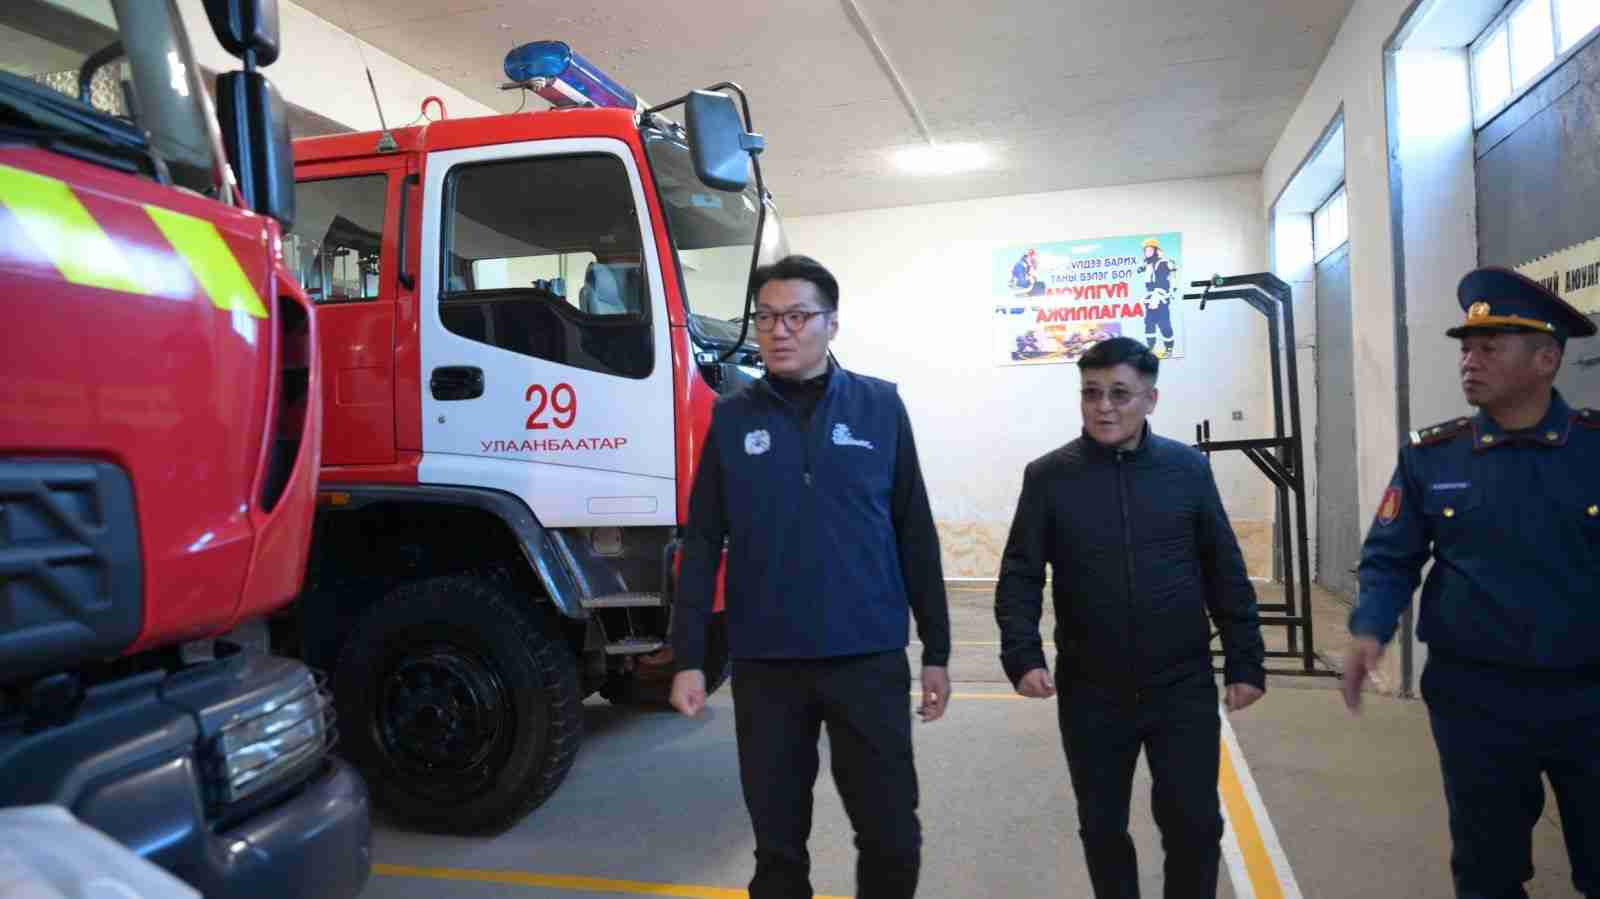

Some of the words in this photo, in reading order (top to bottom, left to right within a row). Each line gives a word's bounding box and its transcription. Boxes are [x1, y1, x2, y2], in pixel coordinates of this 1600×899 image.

[1104, 255, 1137, 267] БАРИХ
[1080, 270, 1108, 281] БЭЛЭГ
[1111, 269, 1132, 280] БОЛ
[1036, 302, 1144, 323] АЖИЛЛАГАА
[525, 382, 577, 429] 29
[480, 437, 628, 453] УЛААНБААТАР
